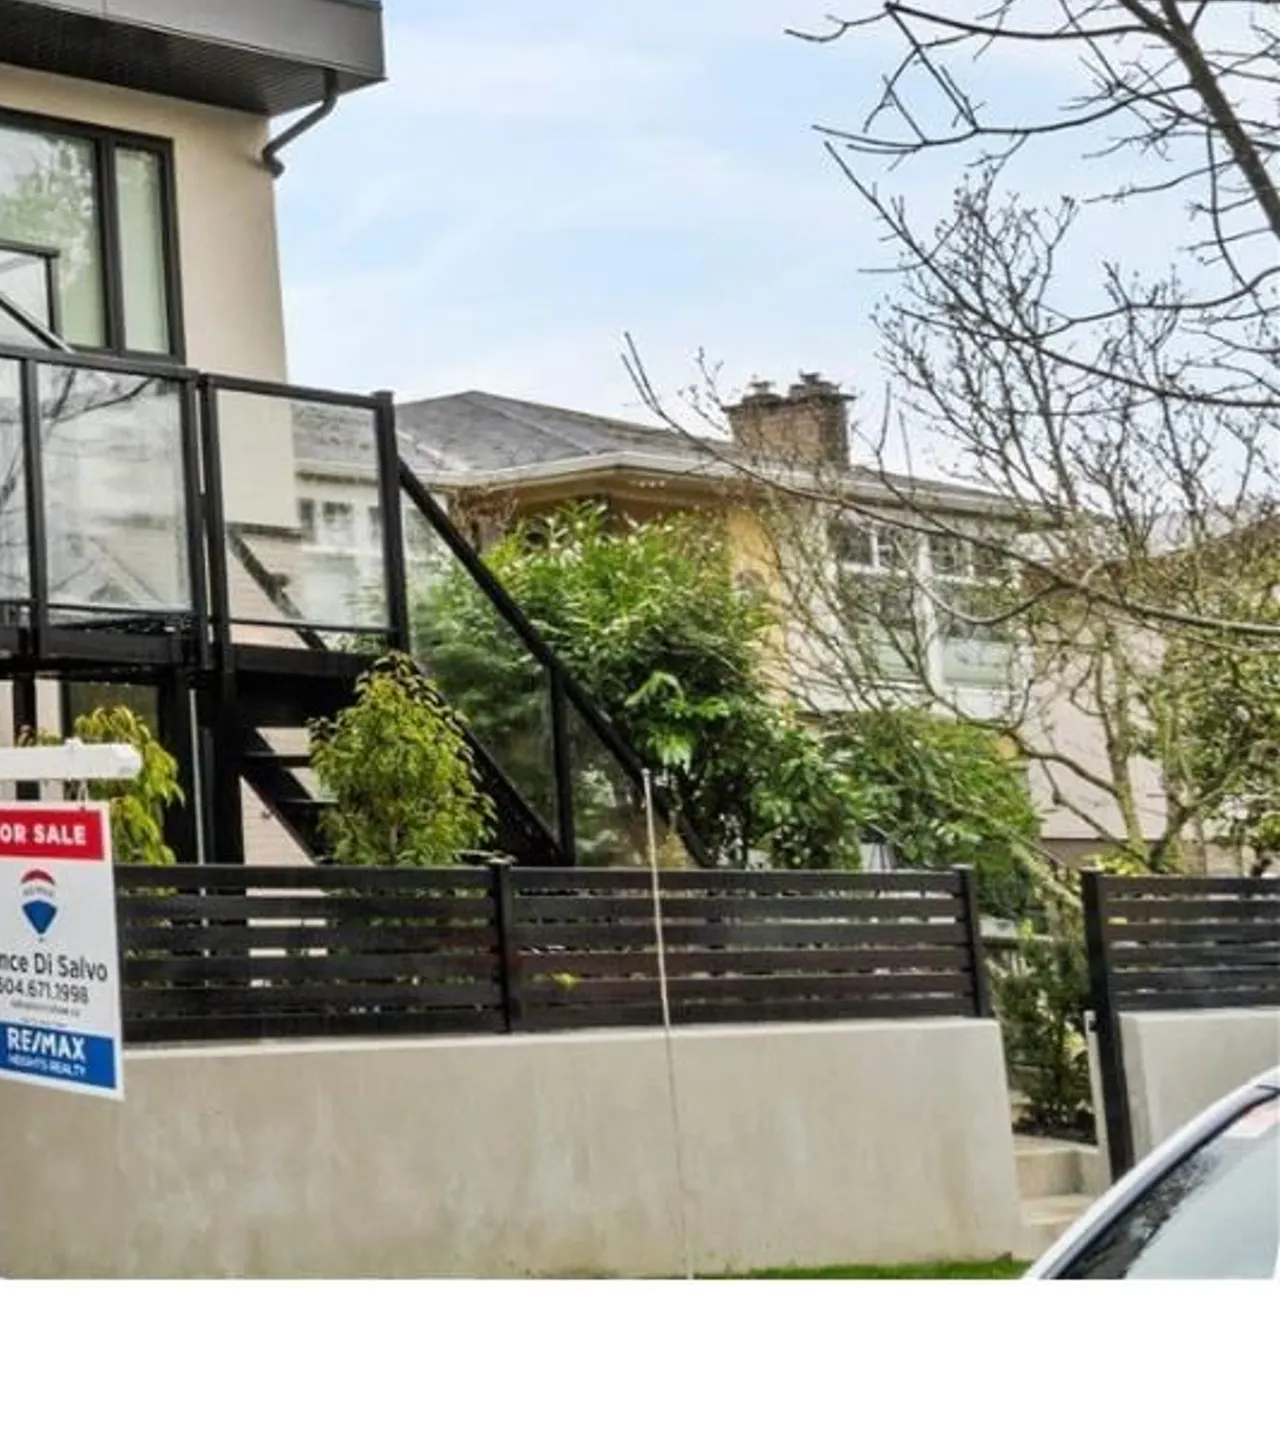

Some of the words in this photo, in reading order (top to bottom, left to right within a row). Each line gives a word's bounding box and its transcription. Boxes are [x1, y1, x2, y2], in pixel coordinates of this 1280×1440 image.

[33, 823, 87, 847] SALE
[34, 952, 53, 976] Di
[58, 955, 108, 981] Salvo
[7, 1026, 87, 1062] RE/MAX
